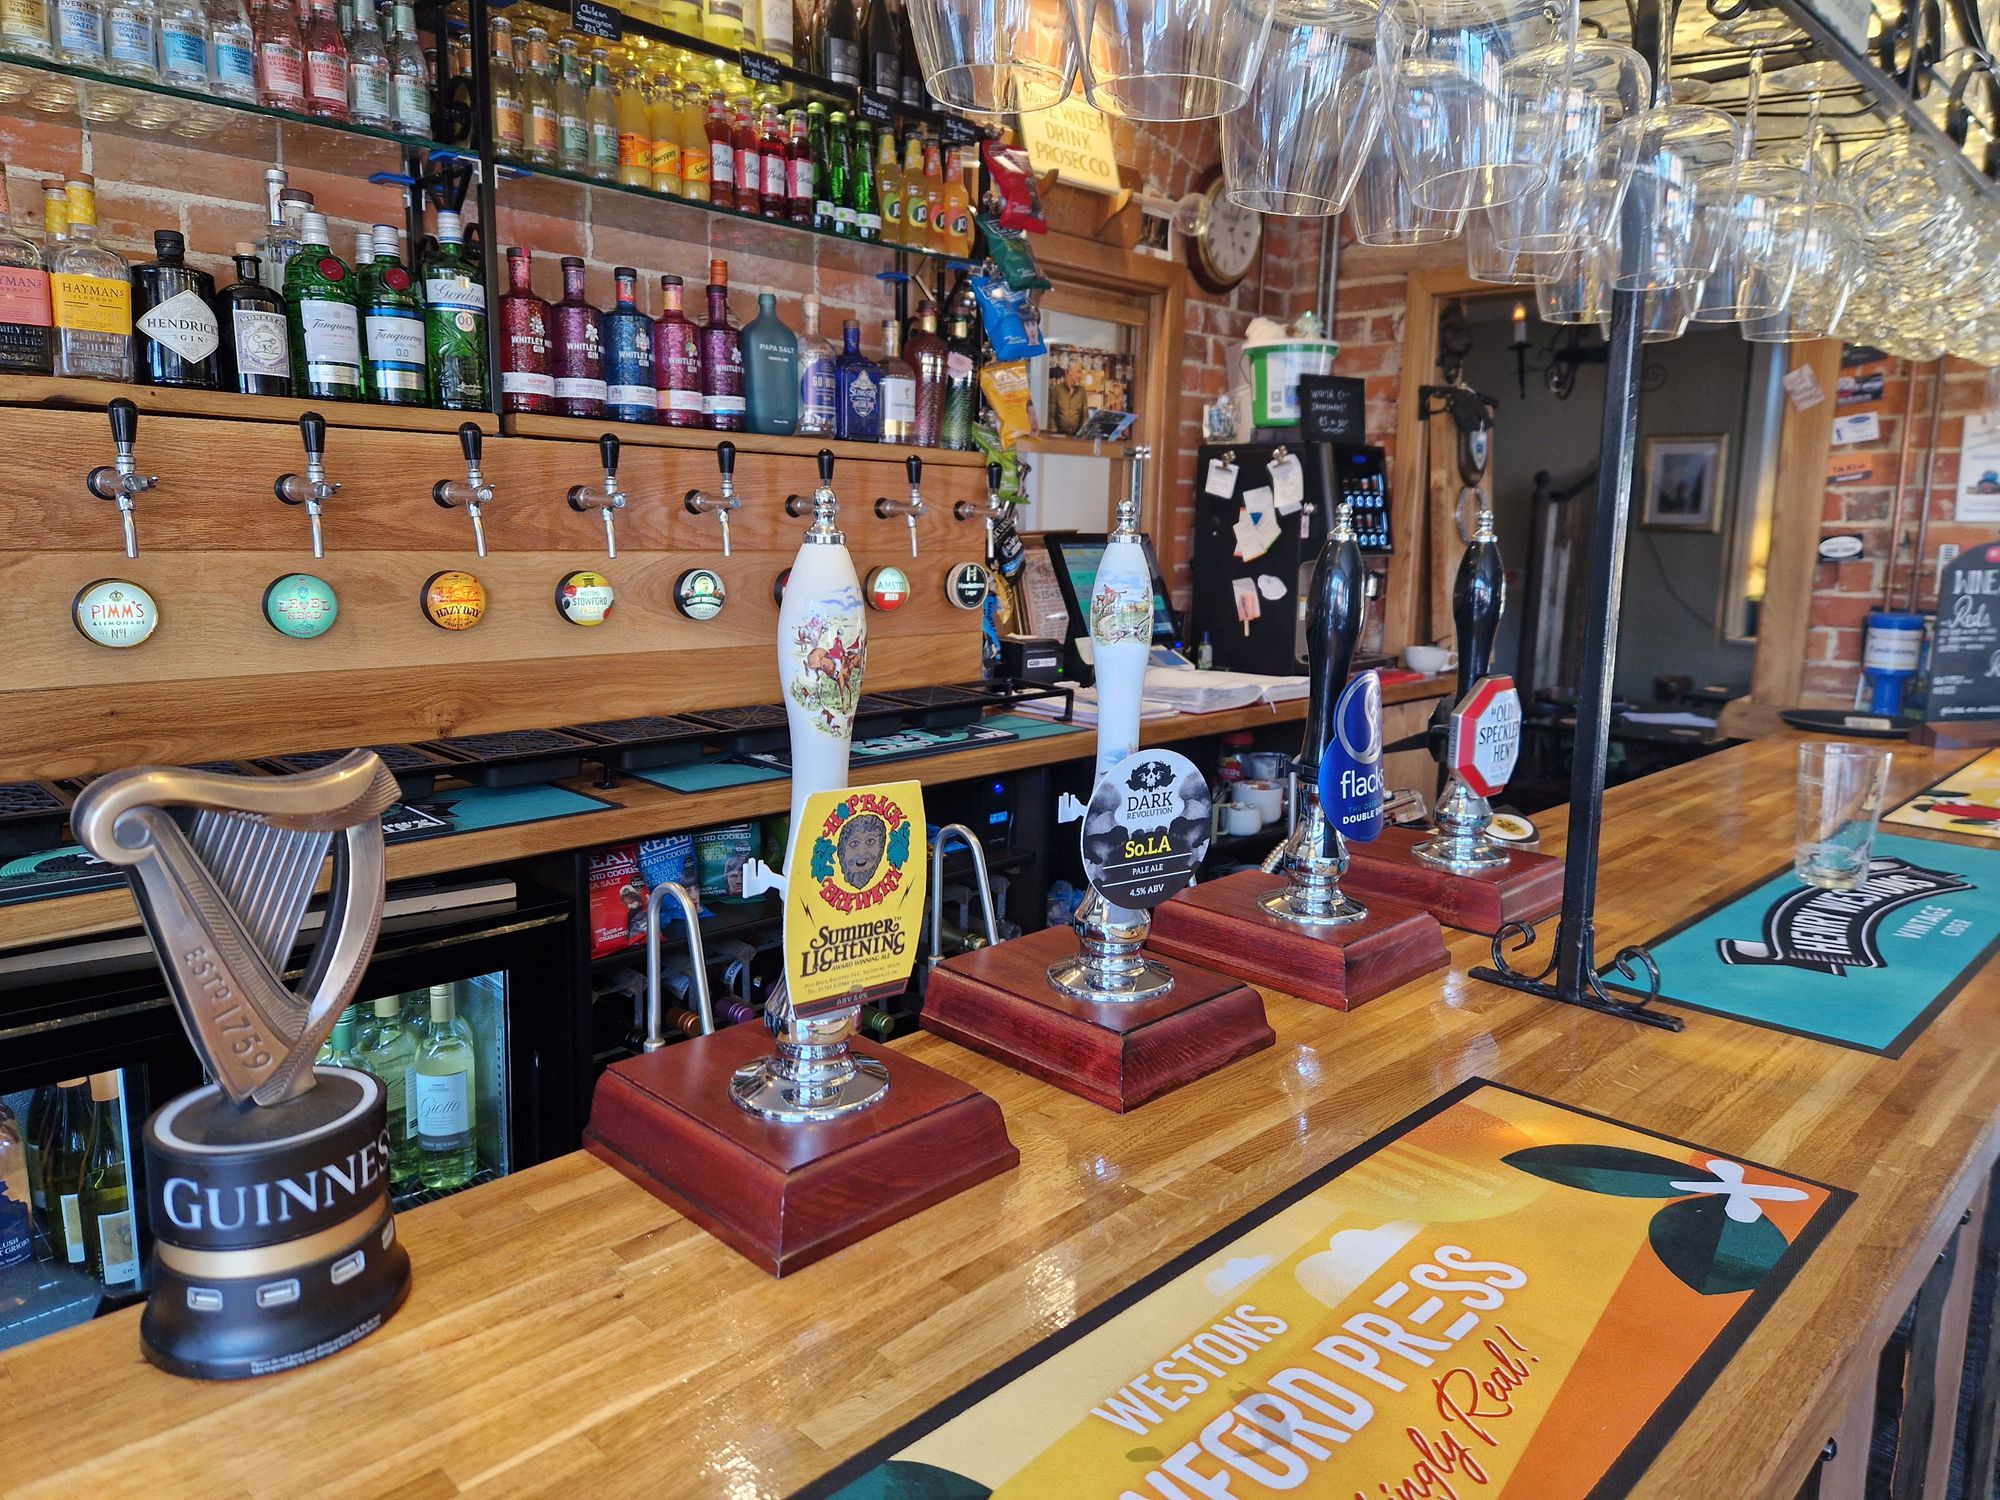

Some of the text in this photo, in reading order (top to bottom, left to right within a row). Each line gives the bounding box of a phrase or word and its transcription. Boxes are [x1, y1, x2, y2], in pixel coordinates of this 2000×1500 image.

[1045, 120, 1092, 151] DRINK
[1035, 142, 1110, 178] PROSECCO
[0, 274, 41, 289] YMANS
[63, 282, 124, 298] HAYMANS
[180, 335, 205, 343] GIN
[375, 328, 423, 345] Tanqueray
[511, 335, 544, 346] WHITLEY
[533, 344, 545, 353] GIN
[566, 342, 598, 351] WHITLEY
[759, 343, 795, 354] PAPA SALT
[587, 351, 599, 360] GIN
[618, 350, 648, 361] WHITLEY
[668, 356, 697, 366] WHITLEY
[638, 358, 650, 367] GIN
[715, 364, 741, 373] WHITLEY
[687, 365, 698, 374] GIN
[965, 589, 977, 597] Lager
[277, 598, 331, 613] LEVEL
[573, 597, 608, 607] STOWFORD
[91, 600, 144, 619] PIMM'S
[288, 611, 321, 620] HEAD
[434, 606, 481, 618] HAZY DAY
[1479, 720, 1520, 745] SPECKLED
[1127, 791, 1173, 812] DARK
[859, 793, 908, 831] BACK
[1126, 807, 1173, 820] REVOLUTION
[1342, 809, 1375, 825] DOUBLE
[717, 832, 751, 840] COOKED
[1125, 836, 1172, 858] So.LA
[589, 851, 634, 869] EAL
[640, 857, 665, 868] HAND
[660, 860, 680, 872] SALT
[652, 867, 677, 879] CIDER
[1132, 864, 1164, 875] PALE ALE
[601, 878, 621, 888] SALT
[819, 863, 902, 915] BREWERY
[1129, 884, 1164, 897] 4.5% ABV
[1790, 874, 1937, 955] HENRY WESTONS
[1892, 904, 1953, 939] VINTAGE
[832, 962, 854, 971] AWARD
[855, 956, 879, 966] WINNING
[212, 1002, 274, 1074] 1759
[163, 1126, 392, 1230] GUINNES
[1090, 1303, 1289, 1437] WESTONS
[1117, 1244, 1529, 1500] FORD PRESS
[1433, 1324, 1542, 1448] Real!
